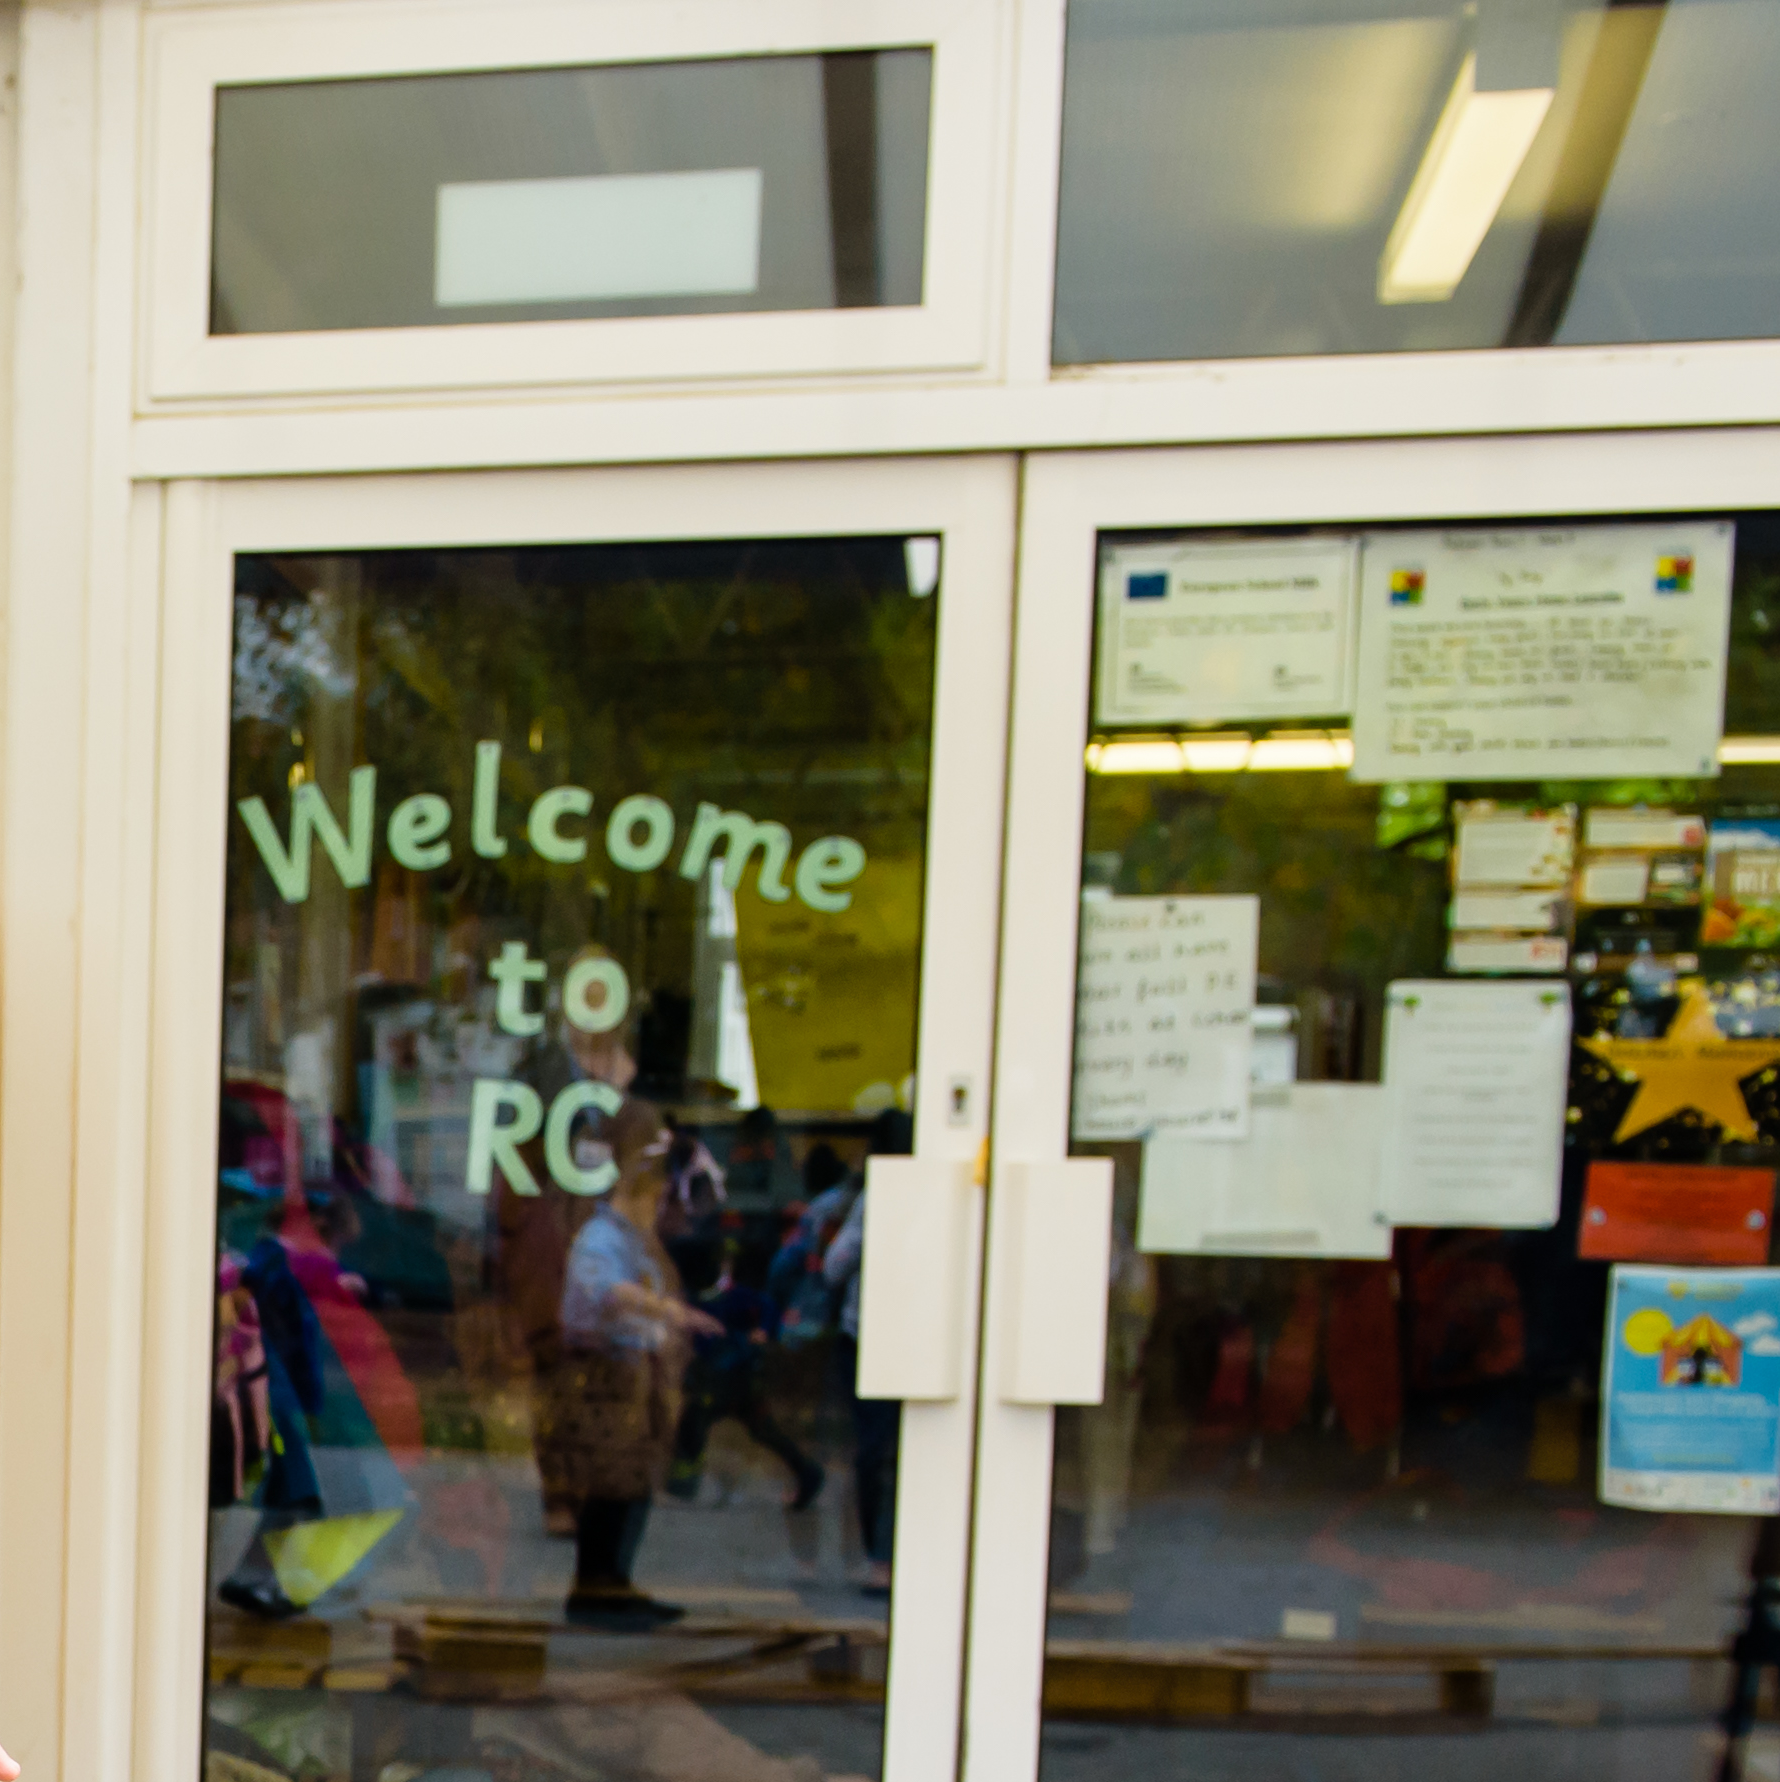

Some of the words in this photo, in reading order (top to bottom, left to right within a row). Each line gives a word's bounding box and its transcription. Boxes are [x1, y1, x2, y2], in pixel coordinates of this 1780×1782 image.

[237, 739, 867, 912] Welcome
[488, 941, 630, 1037] to
[466, 1078, 624, 1197] RC
